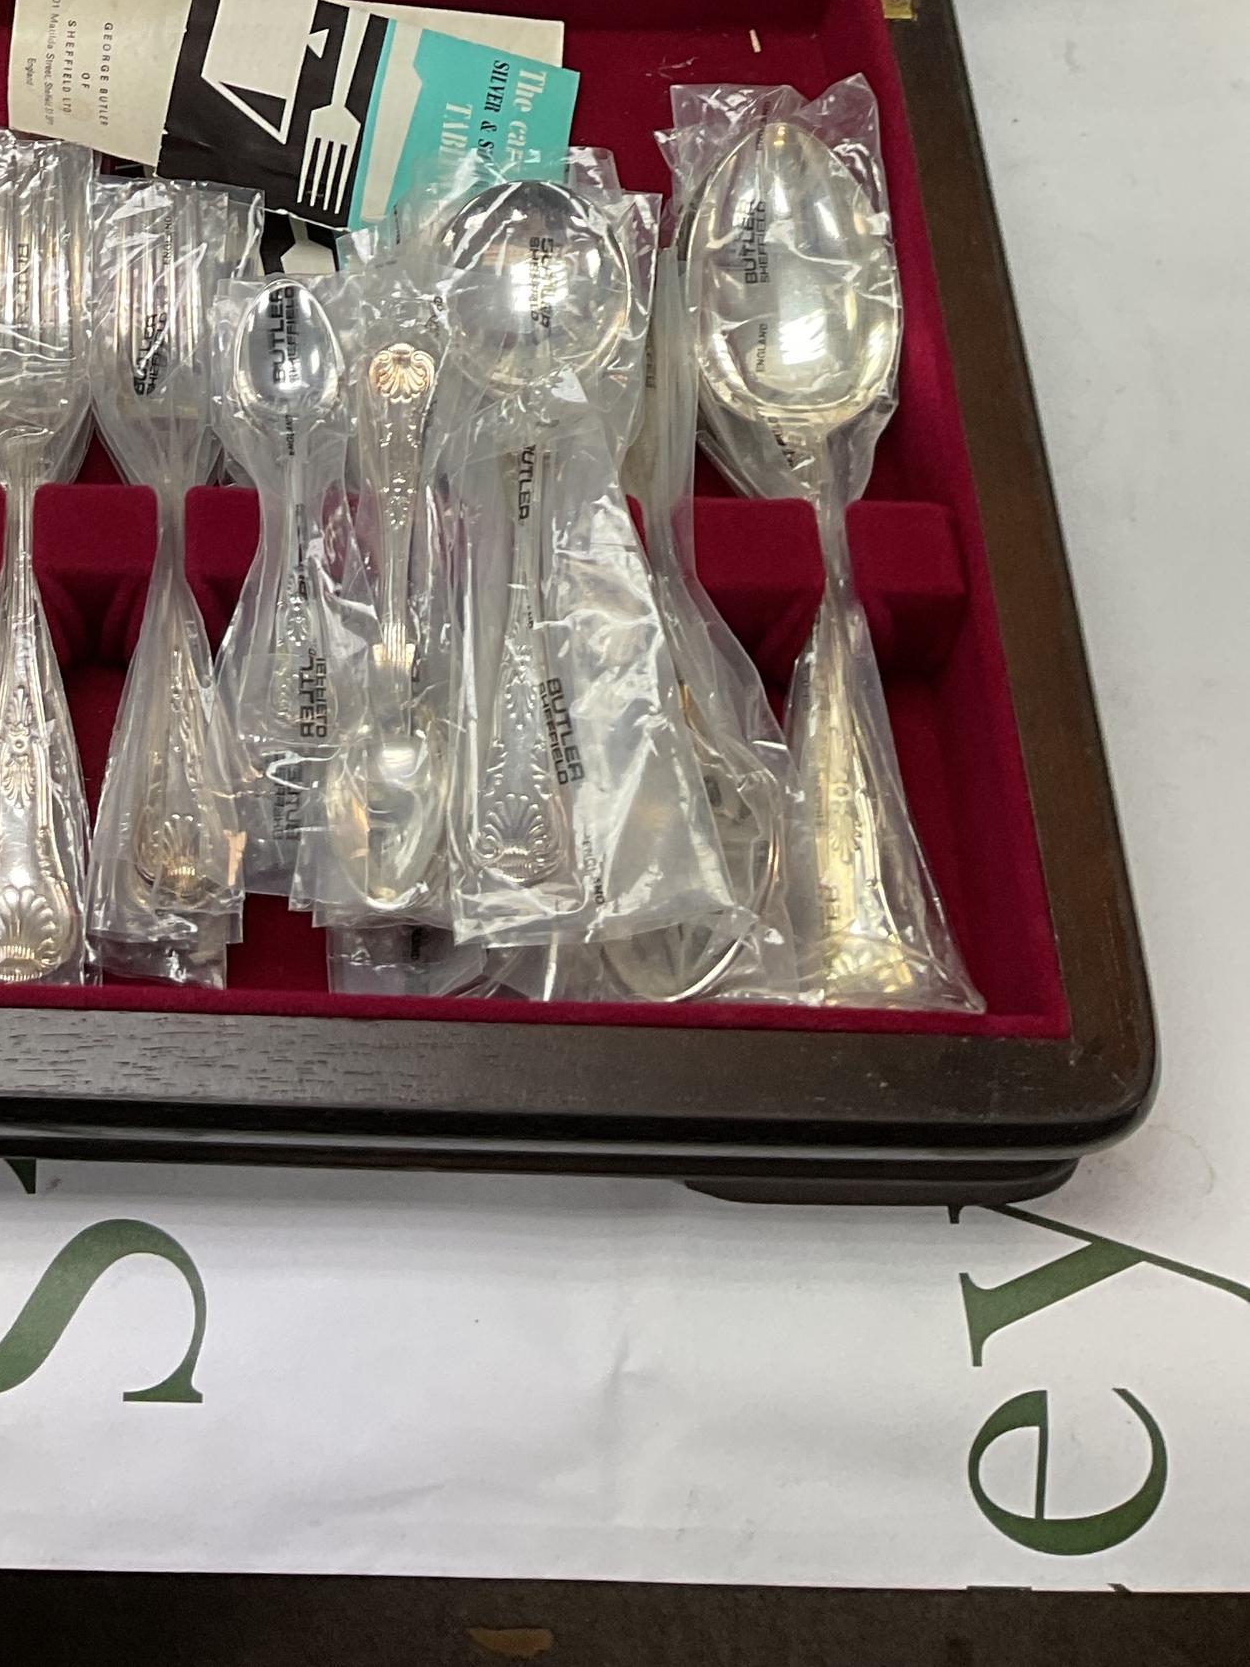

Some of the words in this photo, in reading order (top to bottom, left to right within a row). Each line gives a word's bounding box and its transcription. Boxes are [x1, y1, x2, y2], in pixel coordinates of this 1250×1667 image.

[47, 13, 60, 49] Matilda
[99, 22, 114, 82] GEORGE
[25, 57, 37, 86] England
[62, 19, 77, 93] SHEFFIELD
[81, 72, 91, 90] OF
[484, 60, 510, 113] SILVER
[512, 67, 547, 112] The
[62, 97, 73, 113] LTD
[98, 88, 110, 127] BUTLER
[480, 121, 496, 133] &
[755, 323, 769, 373] ENGLAND
[547, 676, 585, 783] BUTLER
